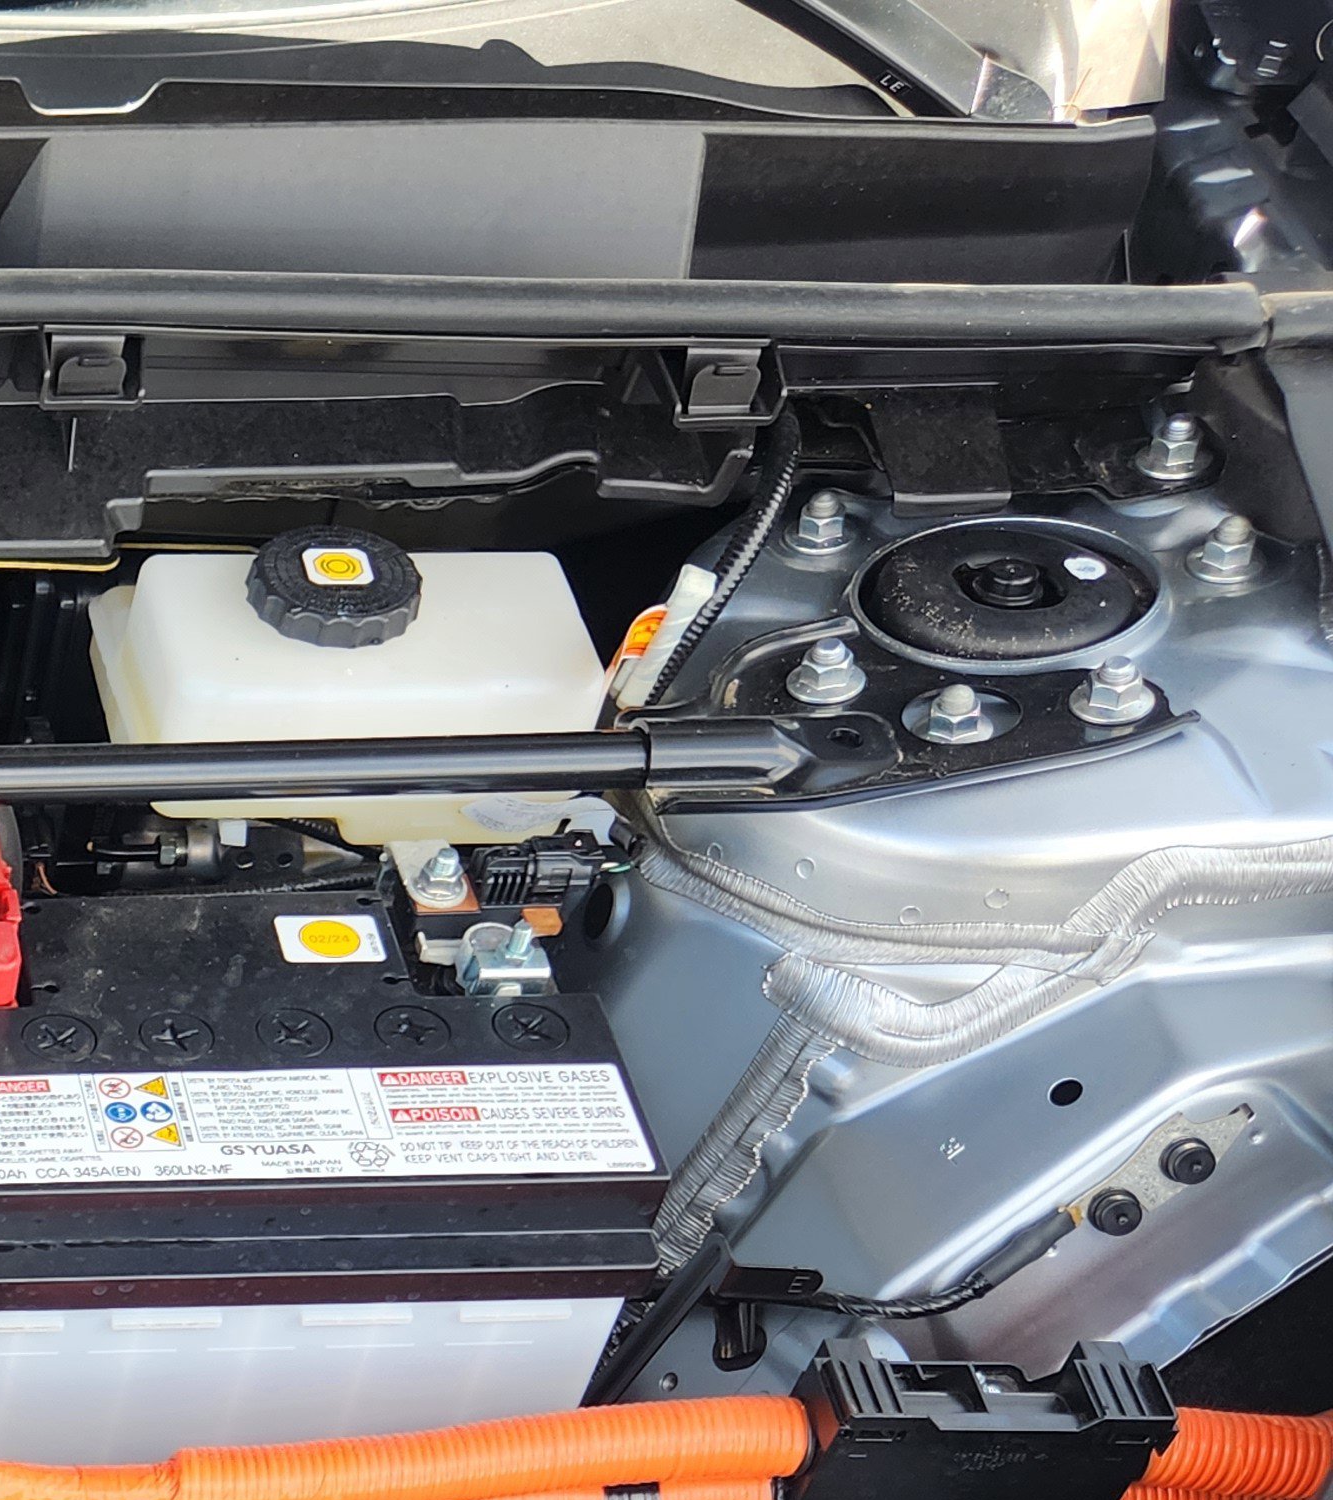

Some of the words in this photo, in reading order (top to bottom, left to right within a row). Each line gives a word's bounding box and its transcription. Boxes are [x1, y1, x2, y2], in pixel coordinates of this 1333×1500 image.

[880, 74, 905, 93] LE
[309, 934, 350, 944] 02/24
[398, 1073, 463, 1085] DANGER
[469, 1071, 551, 1084] EXPLOSIVE
[558, 1070, 610, 1083] GASES
[410, 1108, 476, 1121] POISON
[481, 1107, 530, 1120] CAUSES
[532, 1107, 580, 1119] SEVERE
[584, 1106, 626, 1119] BURNS
[221, 1145, 245, 1155] GS
[247, 1144, 315, 1155] YUASA
[400, 1142, 415, 1151] DO
[416, 1142, 435, 1151] NOT
[438, 1141, 452, 1150] TIP
[460, 1140, 483, 1150] KEEP
[485, 1140, 504, 1149] OUT
[506, 1140, 520, 1149] OF
[522, 1140, 541, 1149] THE
[542, 1139, 575, 1149] REACH
[576, 1139, 590, 1148] OF
[591, 1139, 638, 1148] CHILDREN
[405, 1154, 432, 1164] KEEP
[435, 1153, 465, 1163] VENT
[468, 1153, 498, 1163] CAPS
[499, 1152, 531, 1162] TIGHT
[535, 1151, 559, 1161] AND
[562, 1151, 598, 1161] LEVEL
[36, 1168, 70, 1178] CCA
[73, 1166, 141, 1177] 345A(EN)
[155, 1165, 232, 1176] 360LN2-MF
[787, 1275, 811, 1293] E
